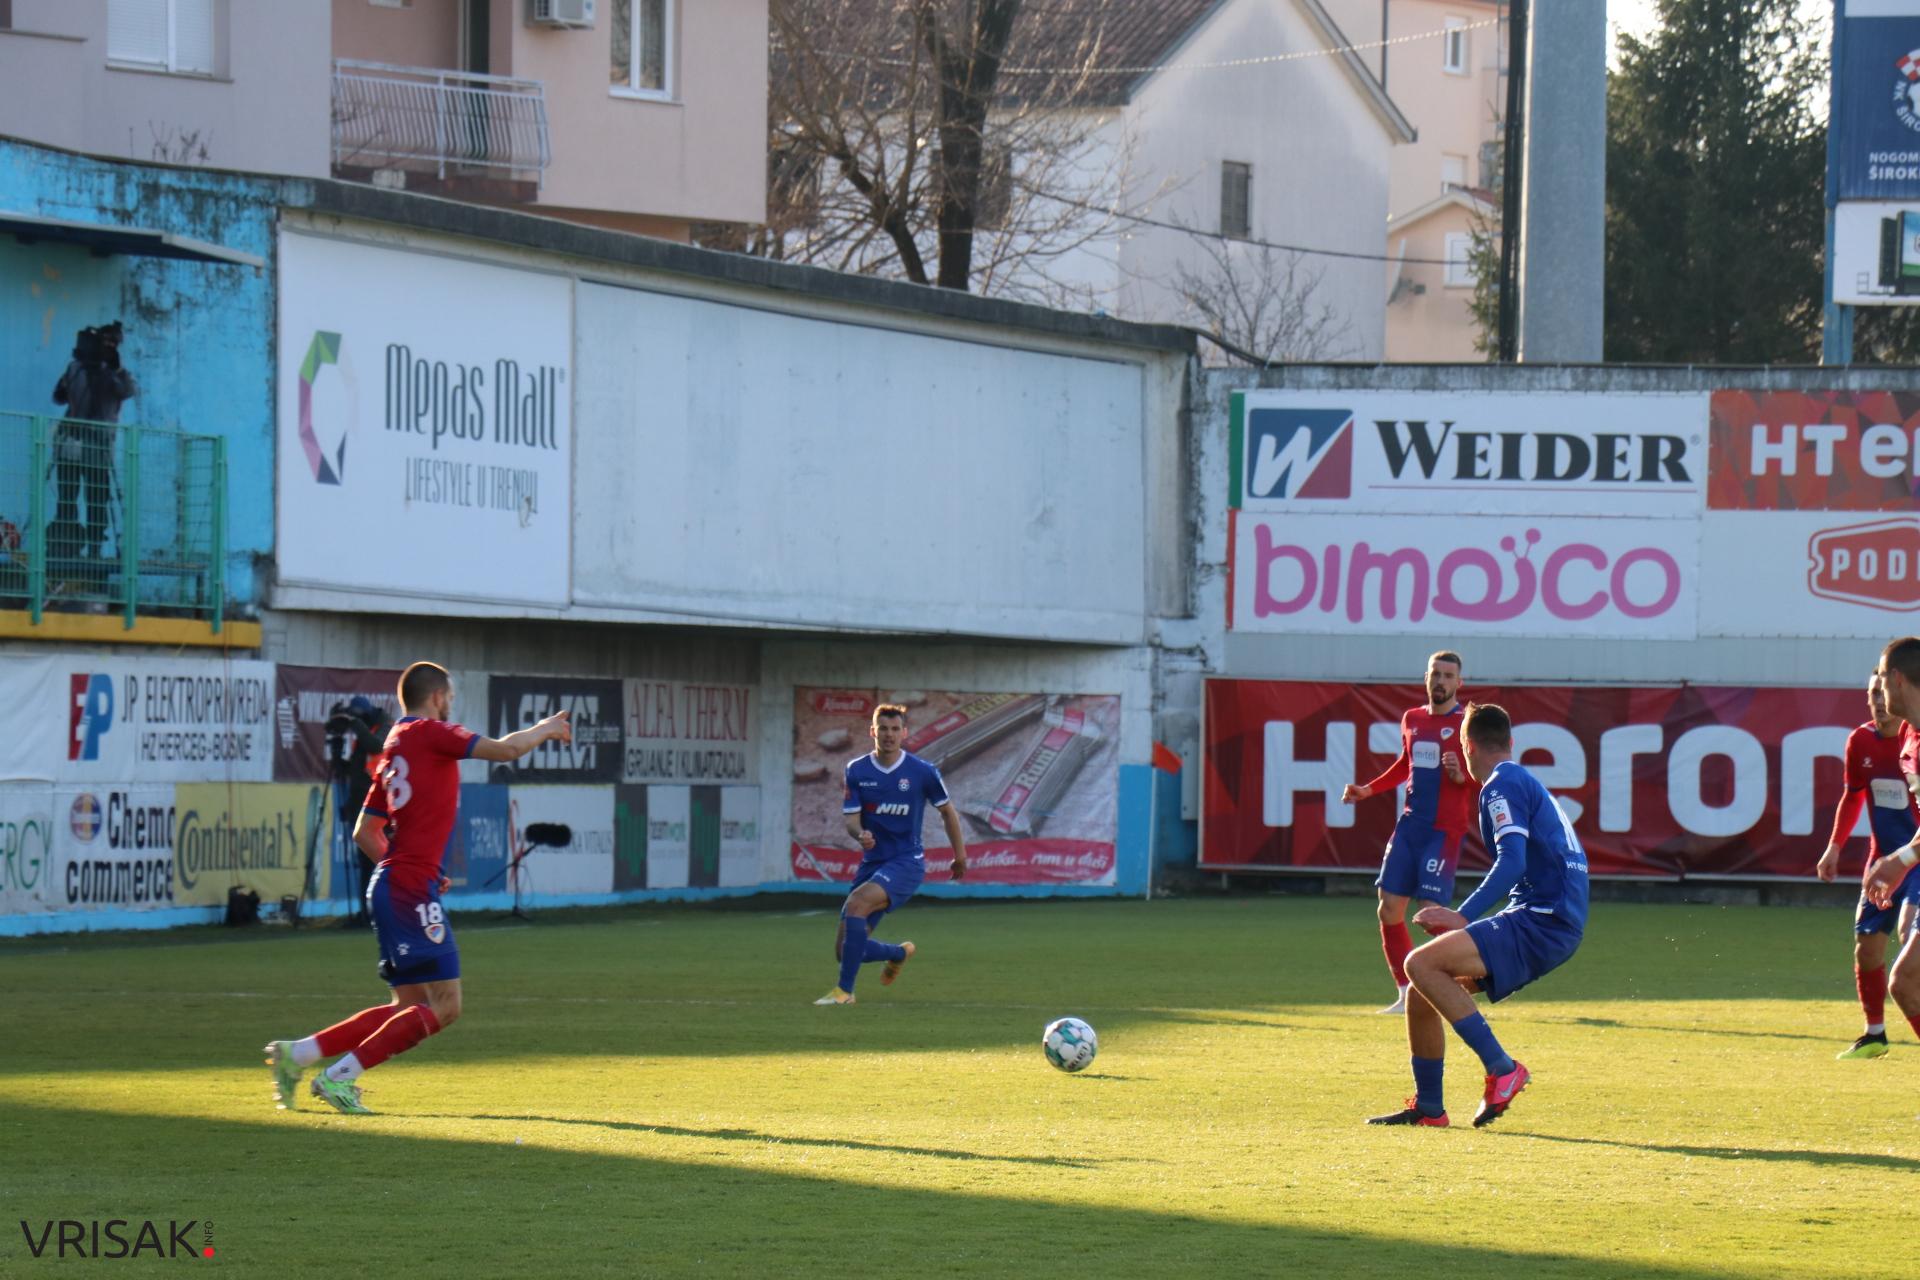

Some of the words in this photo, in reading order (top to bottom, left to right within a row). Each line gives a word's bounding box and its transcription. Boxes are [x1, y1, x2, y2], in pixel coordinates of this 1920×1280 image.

[1868, 151, 1920, 163] NOGOM
[385, 343, 484, 450] Mepas
[495, 358, 558, 450] Mall
[1373, 420, 1695, 483] WEIDER
[1751, 424, 1846, 476] HT
[1860, 424, 1920, 478] e
[404, 456, 472, 507] LIFESTYLE
[477, 465, 487, 509] U
[1831, 548, 1920, 581] POD
[122, 675, 138, 723] JP
[146, 676, 269, 725] ELEKTROPRIVREDA
[178, 809, 283, 890] Continental
[1426, 858, 1446, 877] e!
[66, 858, 174, 904] commerce
[415, 902, 444, 925] 18
